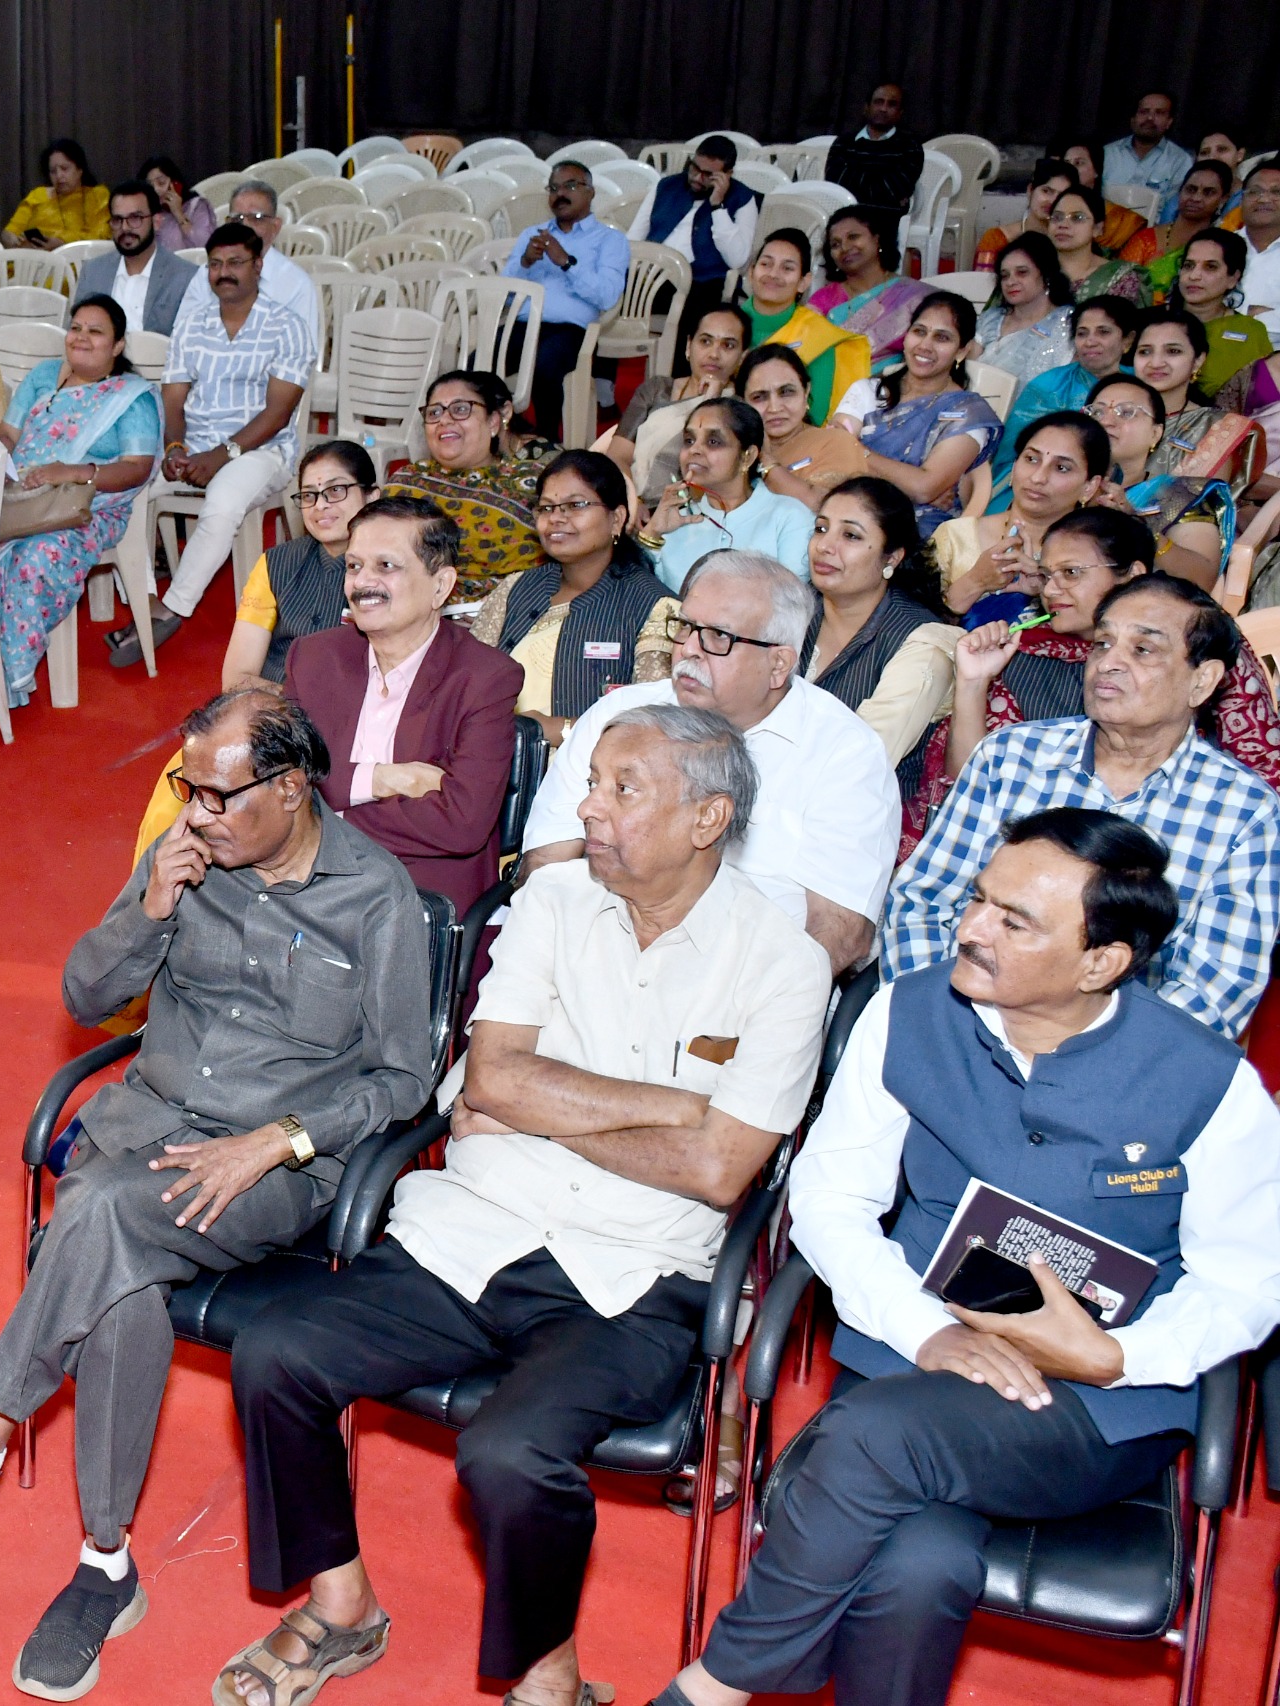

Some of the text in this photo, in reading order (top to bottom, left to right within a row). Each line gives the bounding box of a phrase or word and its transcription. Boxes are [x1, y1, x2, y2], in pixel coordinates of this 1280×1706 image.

[1107, 1166, 1178, 1185] Lions Club of
